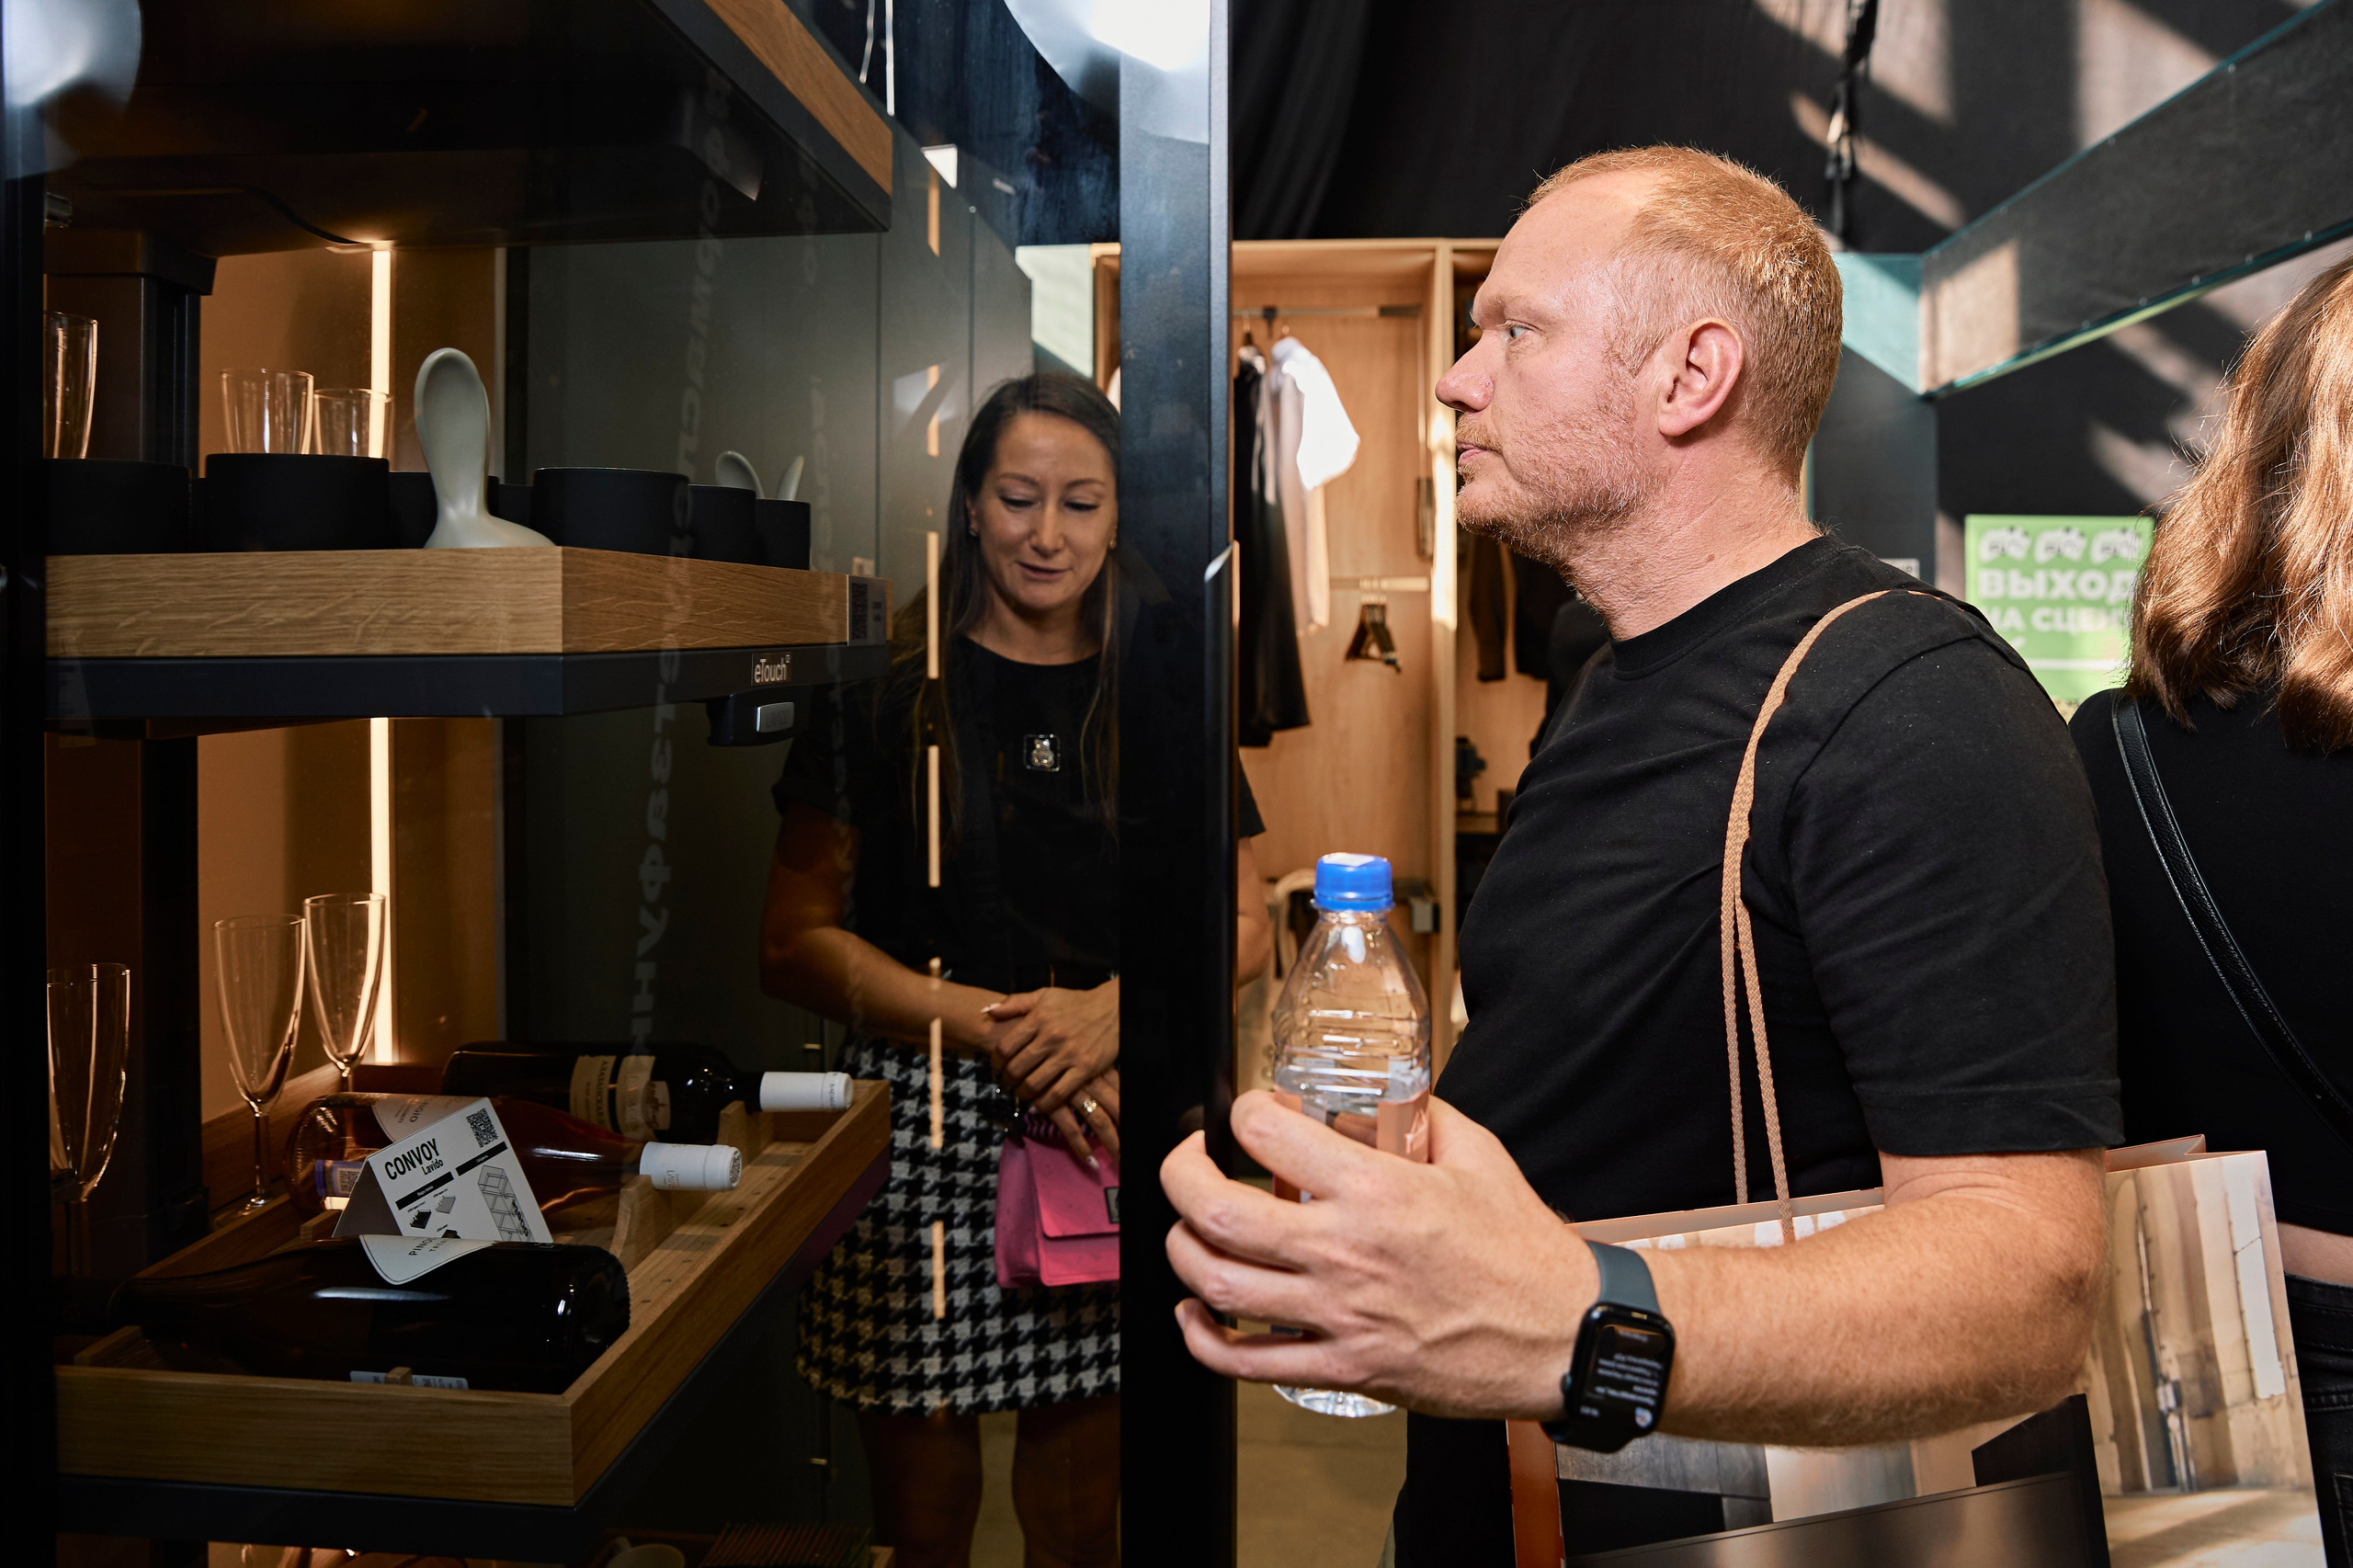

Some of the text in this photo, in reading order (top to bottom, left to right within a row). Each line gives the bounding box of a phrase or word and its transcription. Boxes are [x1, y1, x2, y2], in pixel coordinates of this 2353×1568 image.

[1978, 568, 2134, 606] ВЫХОД
[2029, 605, 2129, 637] СЦЕН
[384, 1137, 440, 1180] CONVOY
[421, 1157, 444, 1176] Lavido
